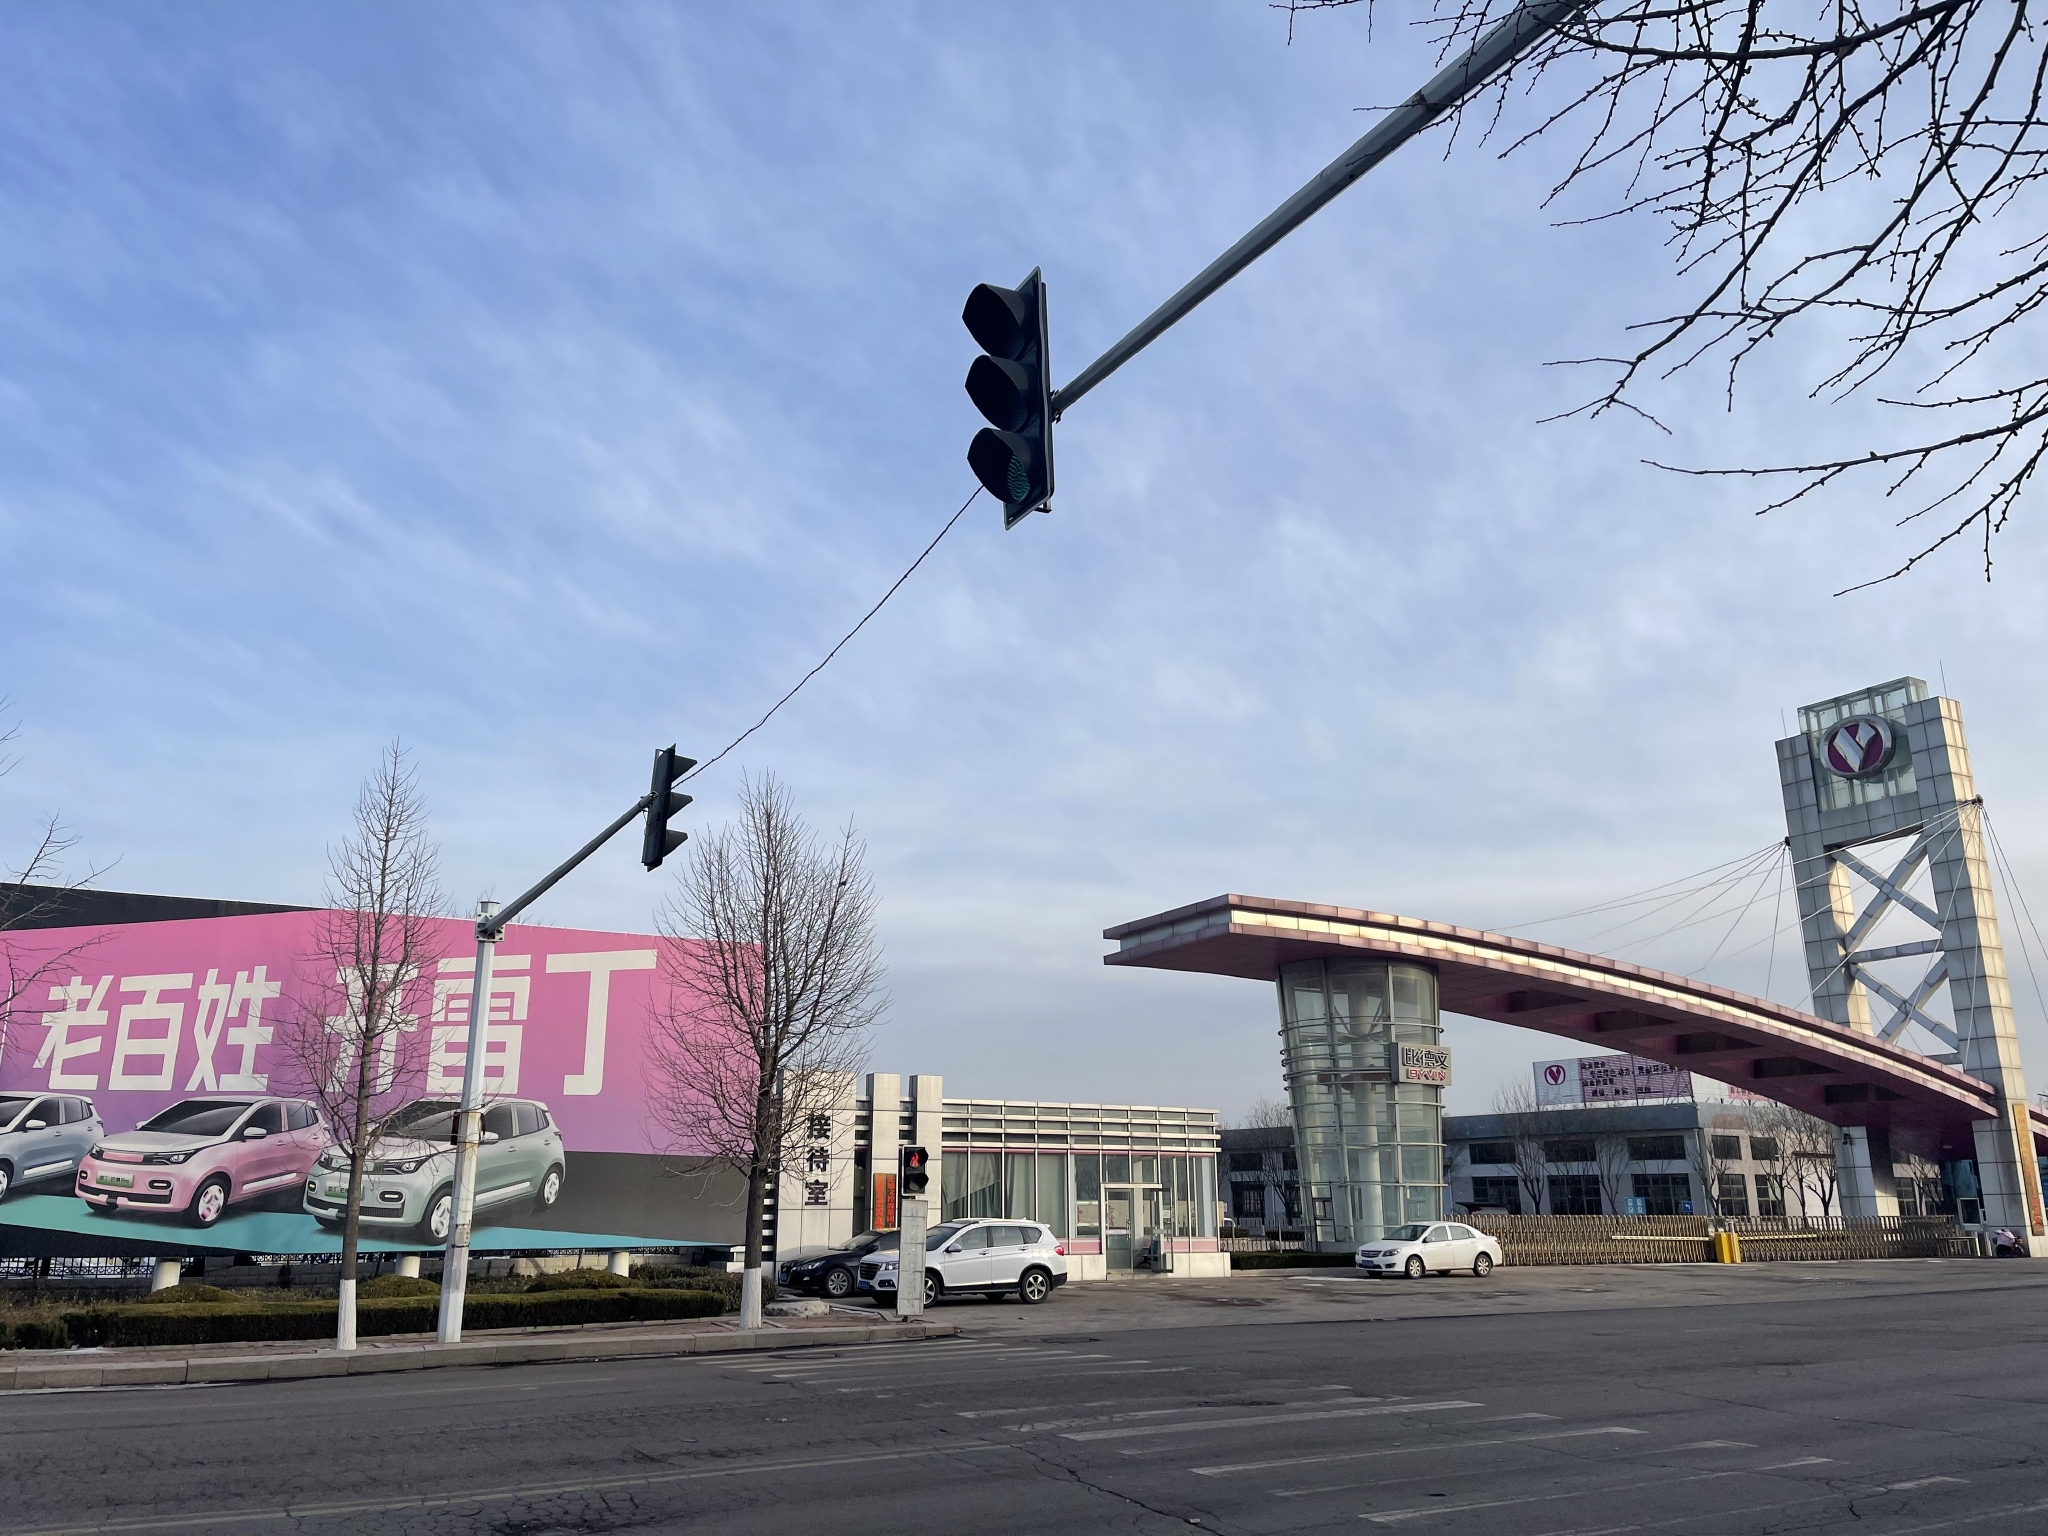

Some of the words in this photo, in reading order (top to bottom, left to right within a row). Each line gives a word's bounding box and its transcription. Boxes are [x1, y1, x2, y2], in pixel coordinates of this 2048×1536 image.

[33, 965, 281, 1092] 老百姓
[325, 949, 658, 1096] 开雷丁
[1402, 1046, 1449, 1069] 比德文
[1408, 1068, 1447, 1081] BYVIN
[804, 1114, 831, 1206] 接待室
